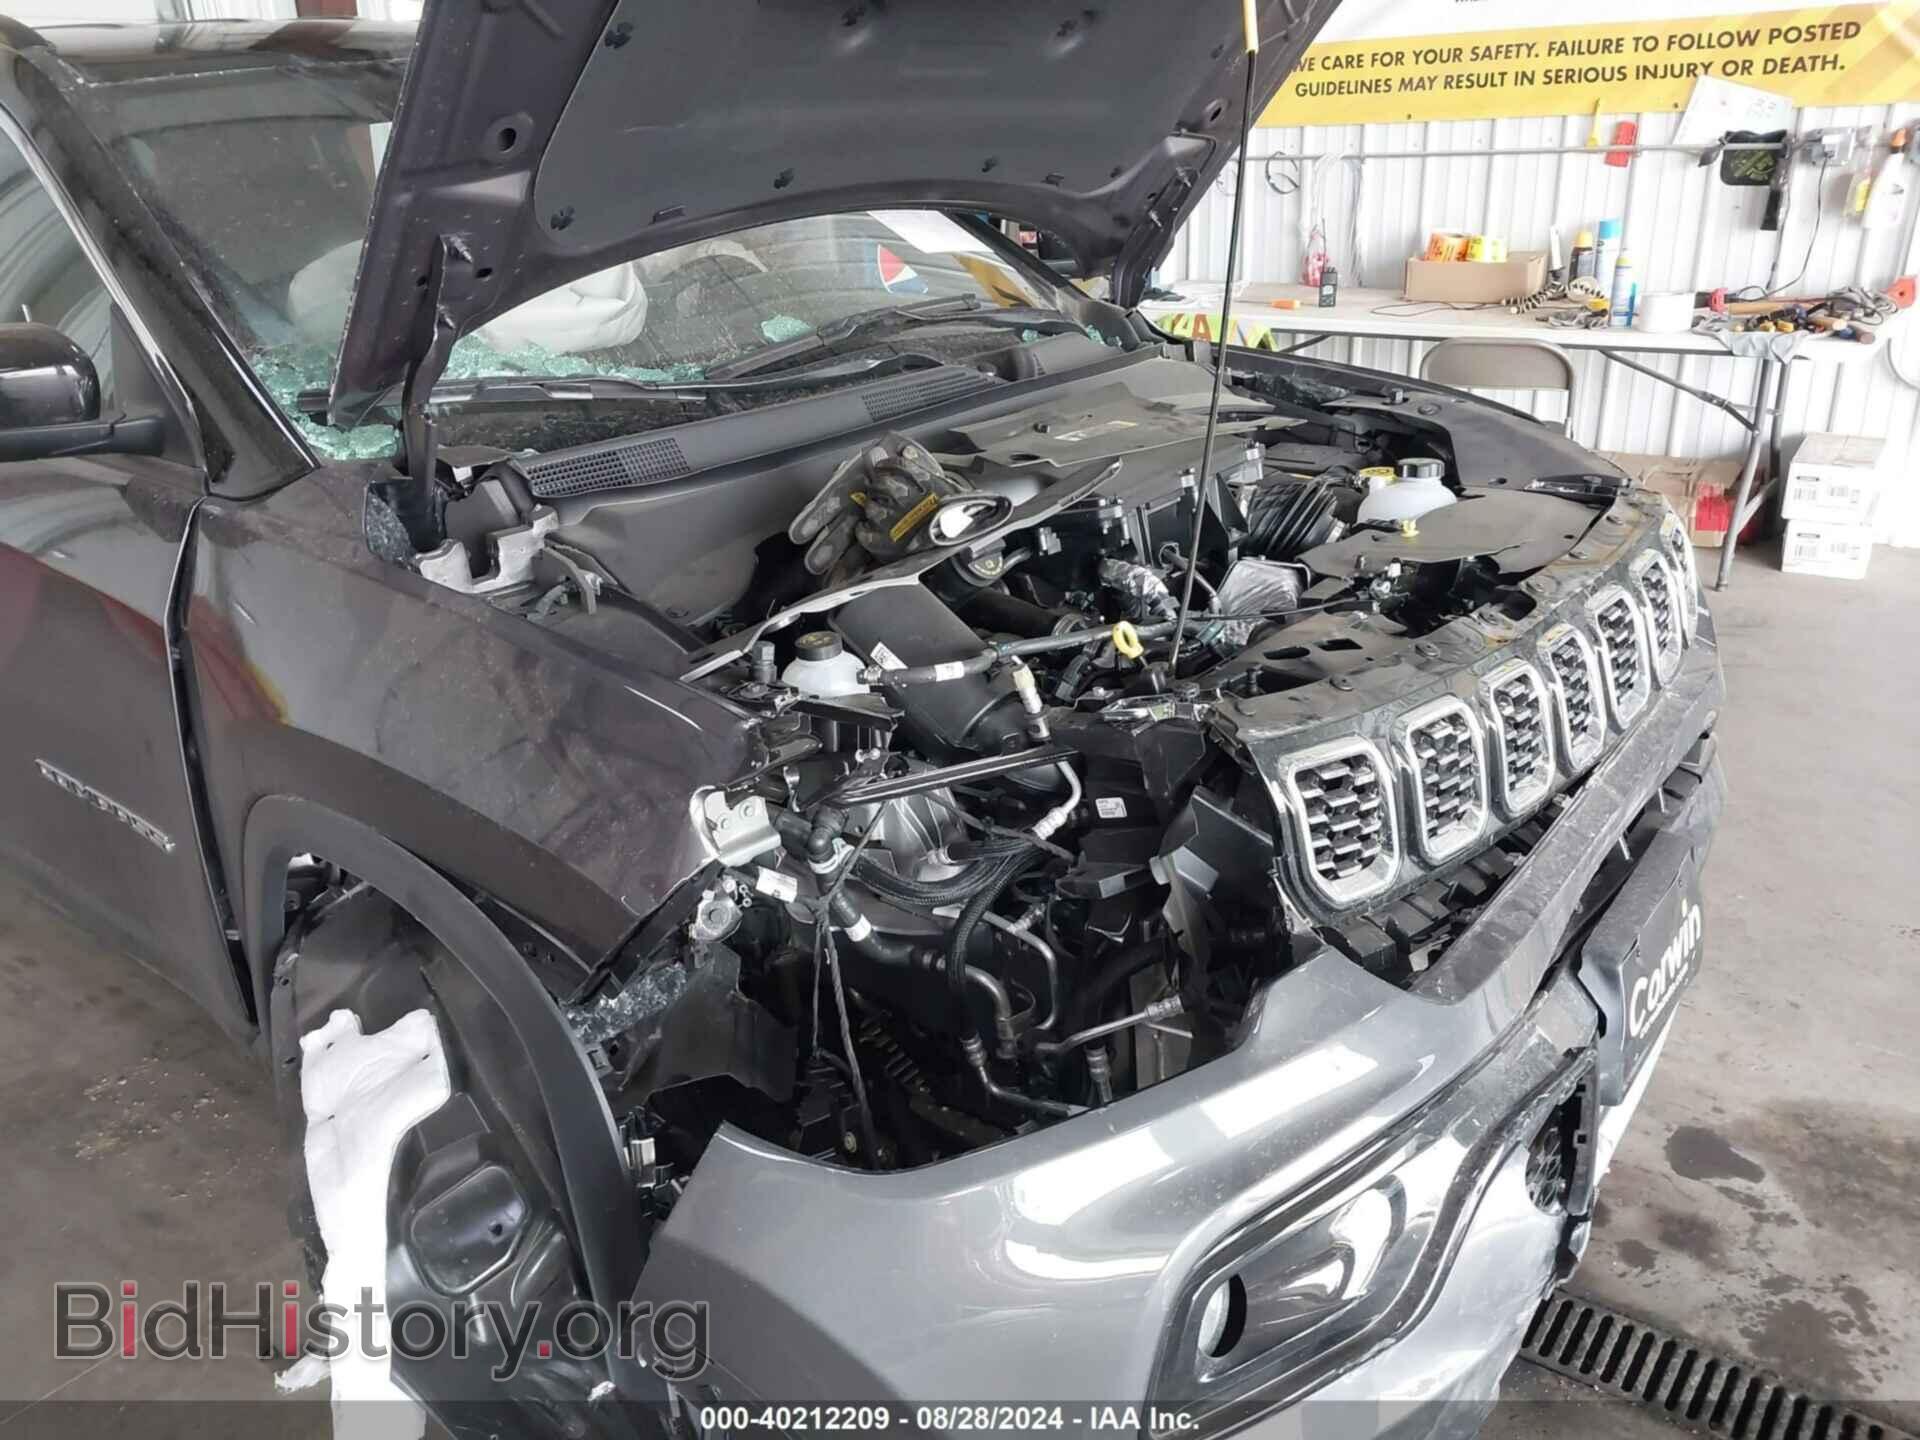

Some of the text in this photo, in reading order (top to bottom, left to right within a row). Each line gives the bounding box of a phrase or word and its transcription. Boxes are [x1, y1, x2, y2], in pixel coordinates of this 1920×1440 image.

[1321, 54, 1364, 71] CARE
[1370, 51, 1404, 68] FOR
[1412, 47, 1463, 65] YOUR
[1469, 42, 1539, 62] SAFETY.
[1547, 37, 1624, 57] FAILURE
[1632, 35, 1659, 53] TO
[1667, 29, 1760, 51] FOLLOW
[1768, 21, 1861, 45] POSTED
[1295, 54, 1846, 97] GUIDELINES MAY RESULT IN SERIOUS INJURY OR DEATH.
[1629, 898, 1701, 1037] Carwin
